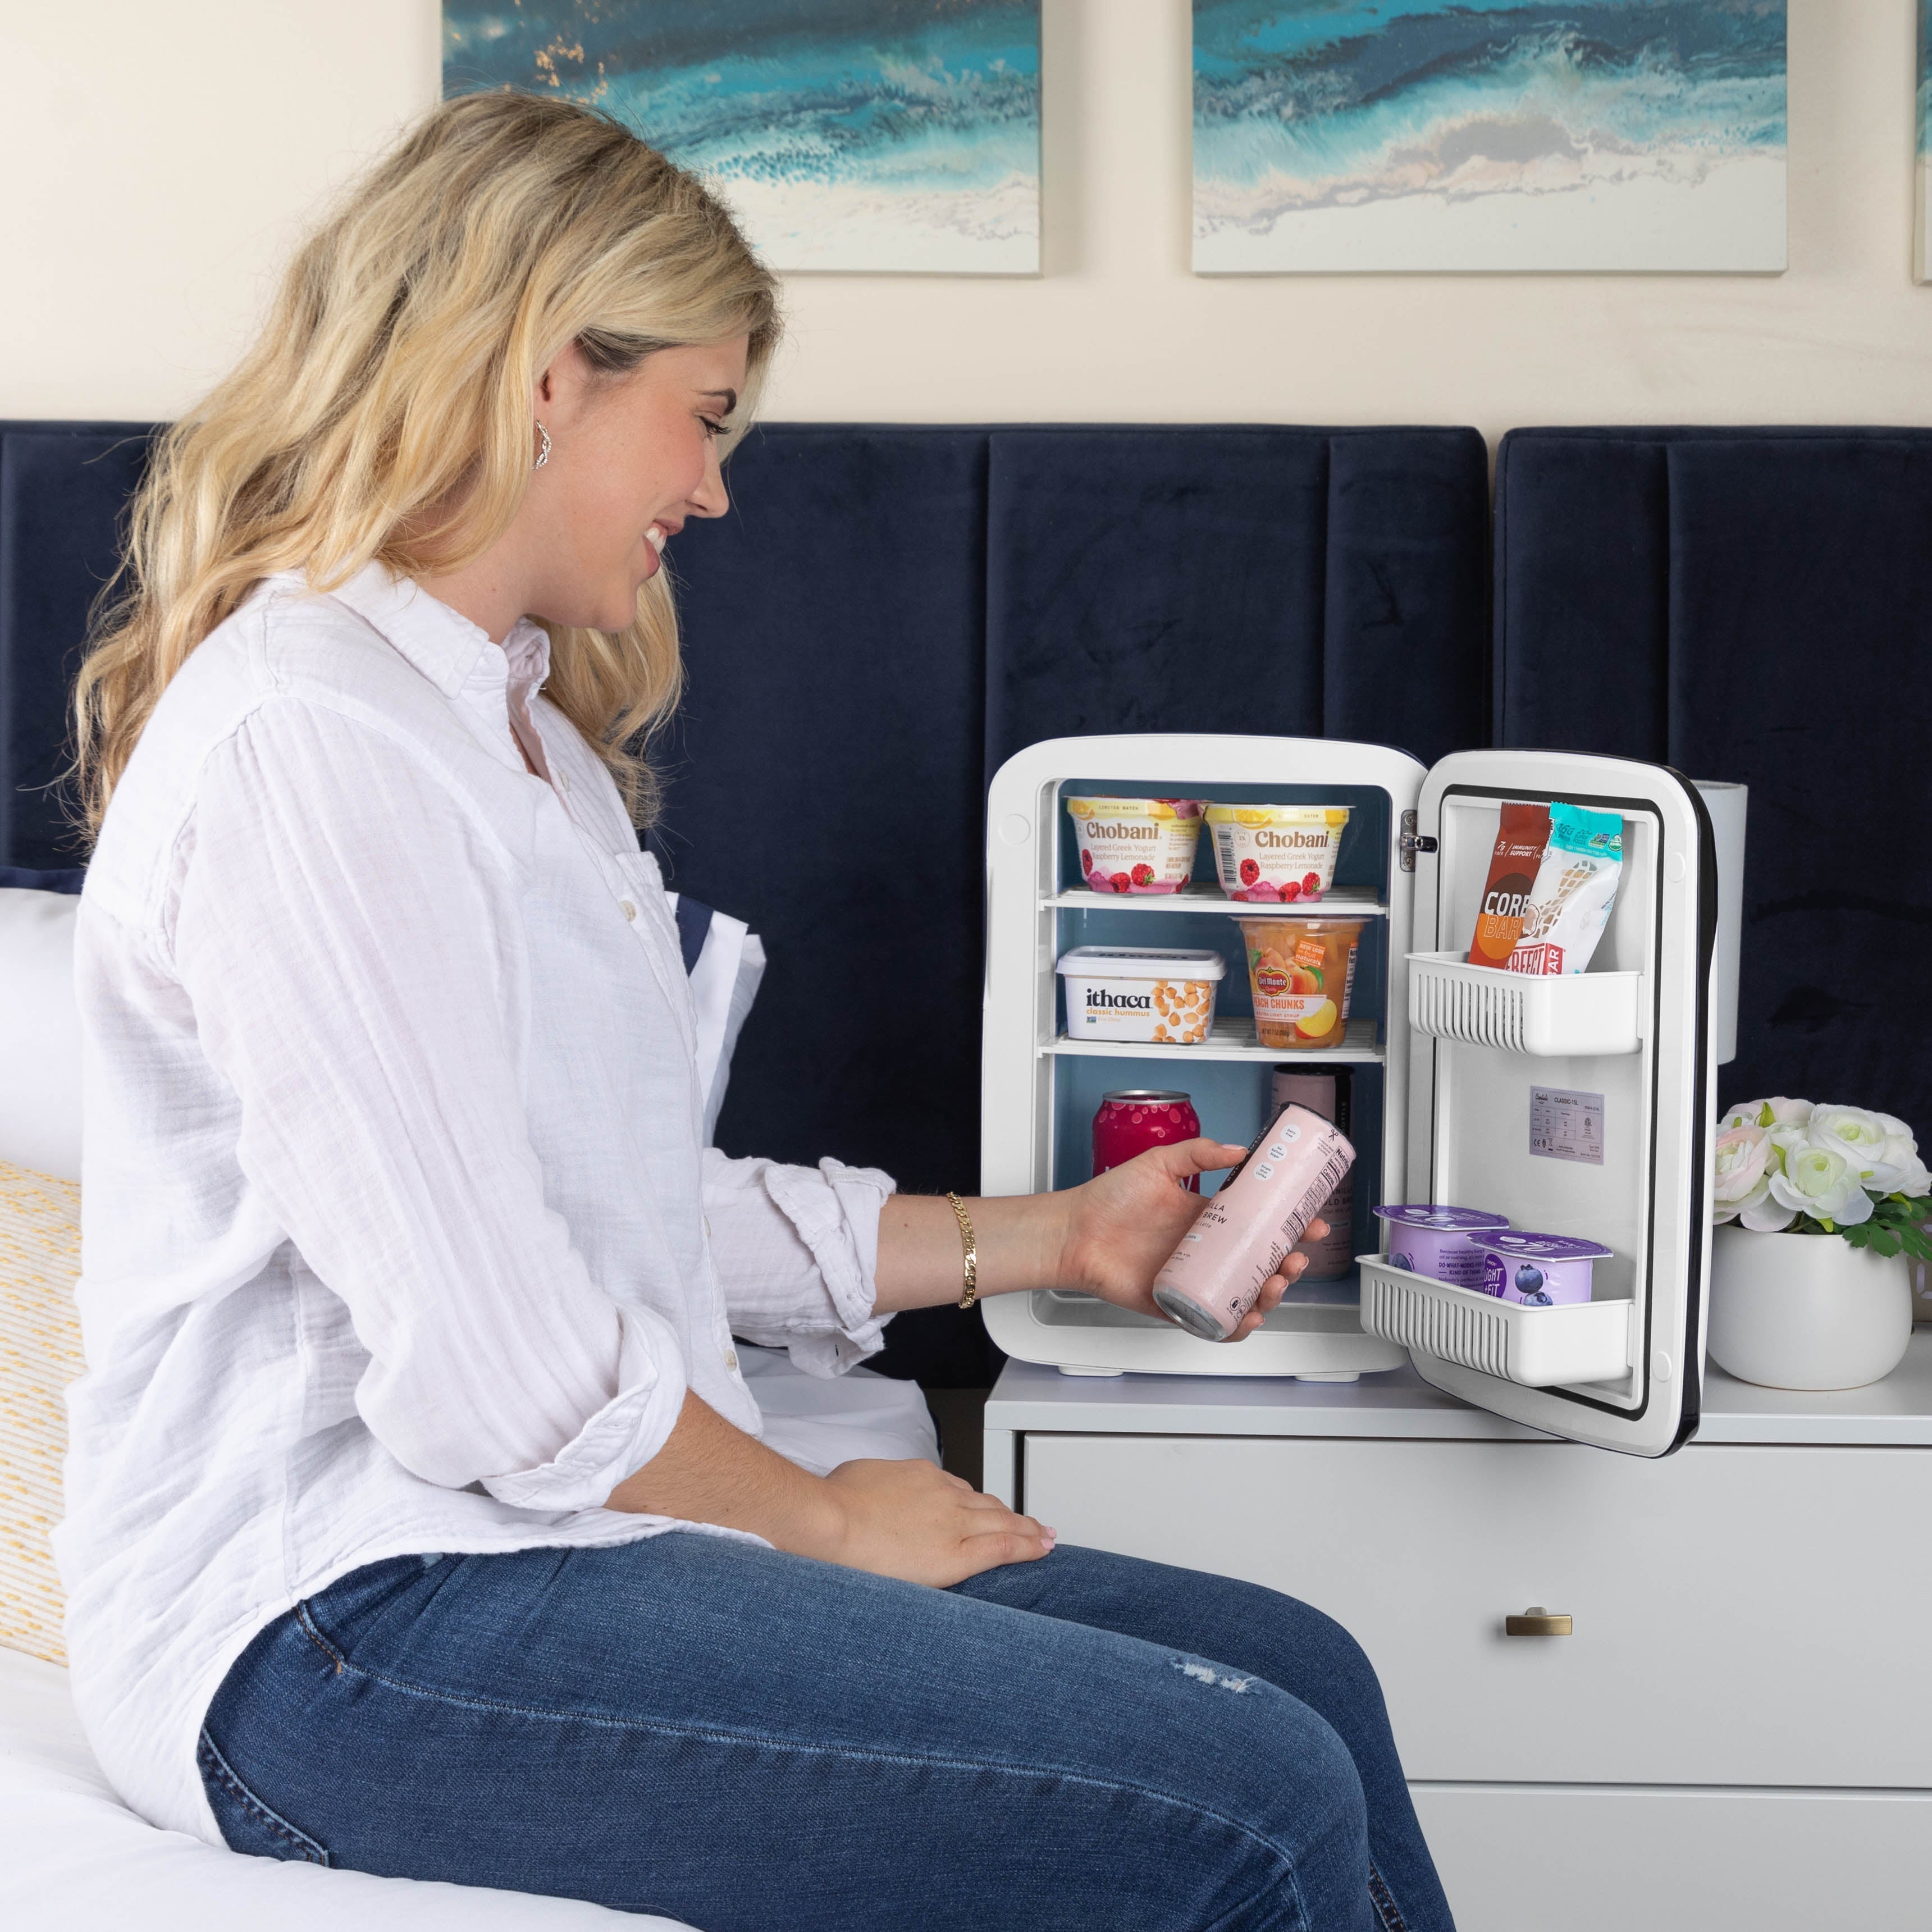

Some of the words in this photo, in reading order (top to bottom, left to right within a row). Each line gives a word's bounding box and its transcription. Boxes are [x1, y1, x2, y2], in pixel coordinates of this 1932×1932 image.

[1086, 822, 1159, 839] Chobani
[1255, 830, 1328, 849] Chobani
[1134, 844, 1156, 853] Yogurt
[1093, 853, 1119, 861] Raspberry
[1308, 853, 1324, 861] Yogurt
[1260, 862, 1293, 871] Raspberry
[1483, 914, 1522, 939] BAR
[1547, 948, 1559, 975] AR
[1086, 988, 1150, 1009] ithaca
[1271, 999, 1305, 1010] CHUNKS
[1115, 1008, 1150, 1017] hummus
